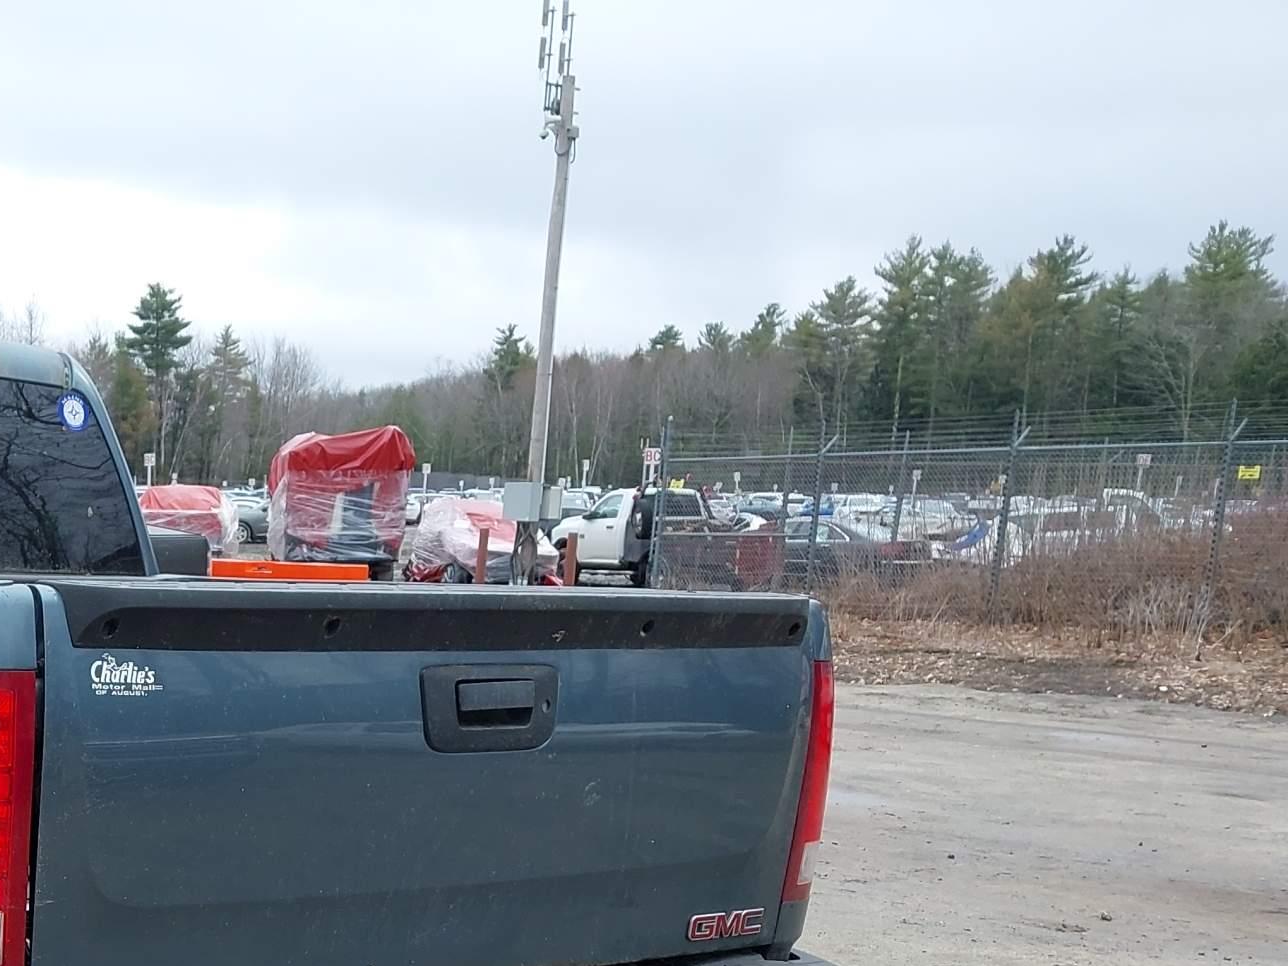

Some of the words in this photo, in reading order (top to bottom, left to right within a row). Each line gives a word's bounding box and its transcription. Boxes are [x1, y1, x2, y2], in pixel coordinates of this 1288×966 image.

[645, 450, 662, 462] BC
[90, 659, 156, 684] Charlie's
[91, 683, 126, 691] Motor
[688, 907, 765, 941] GMC
